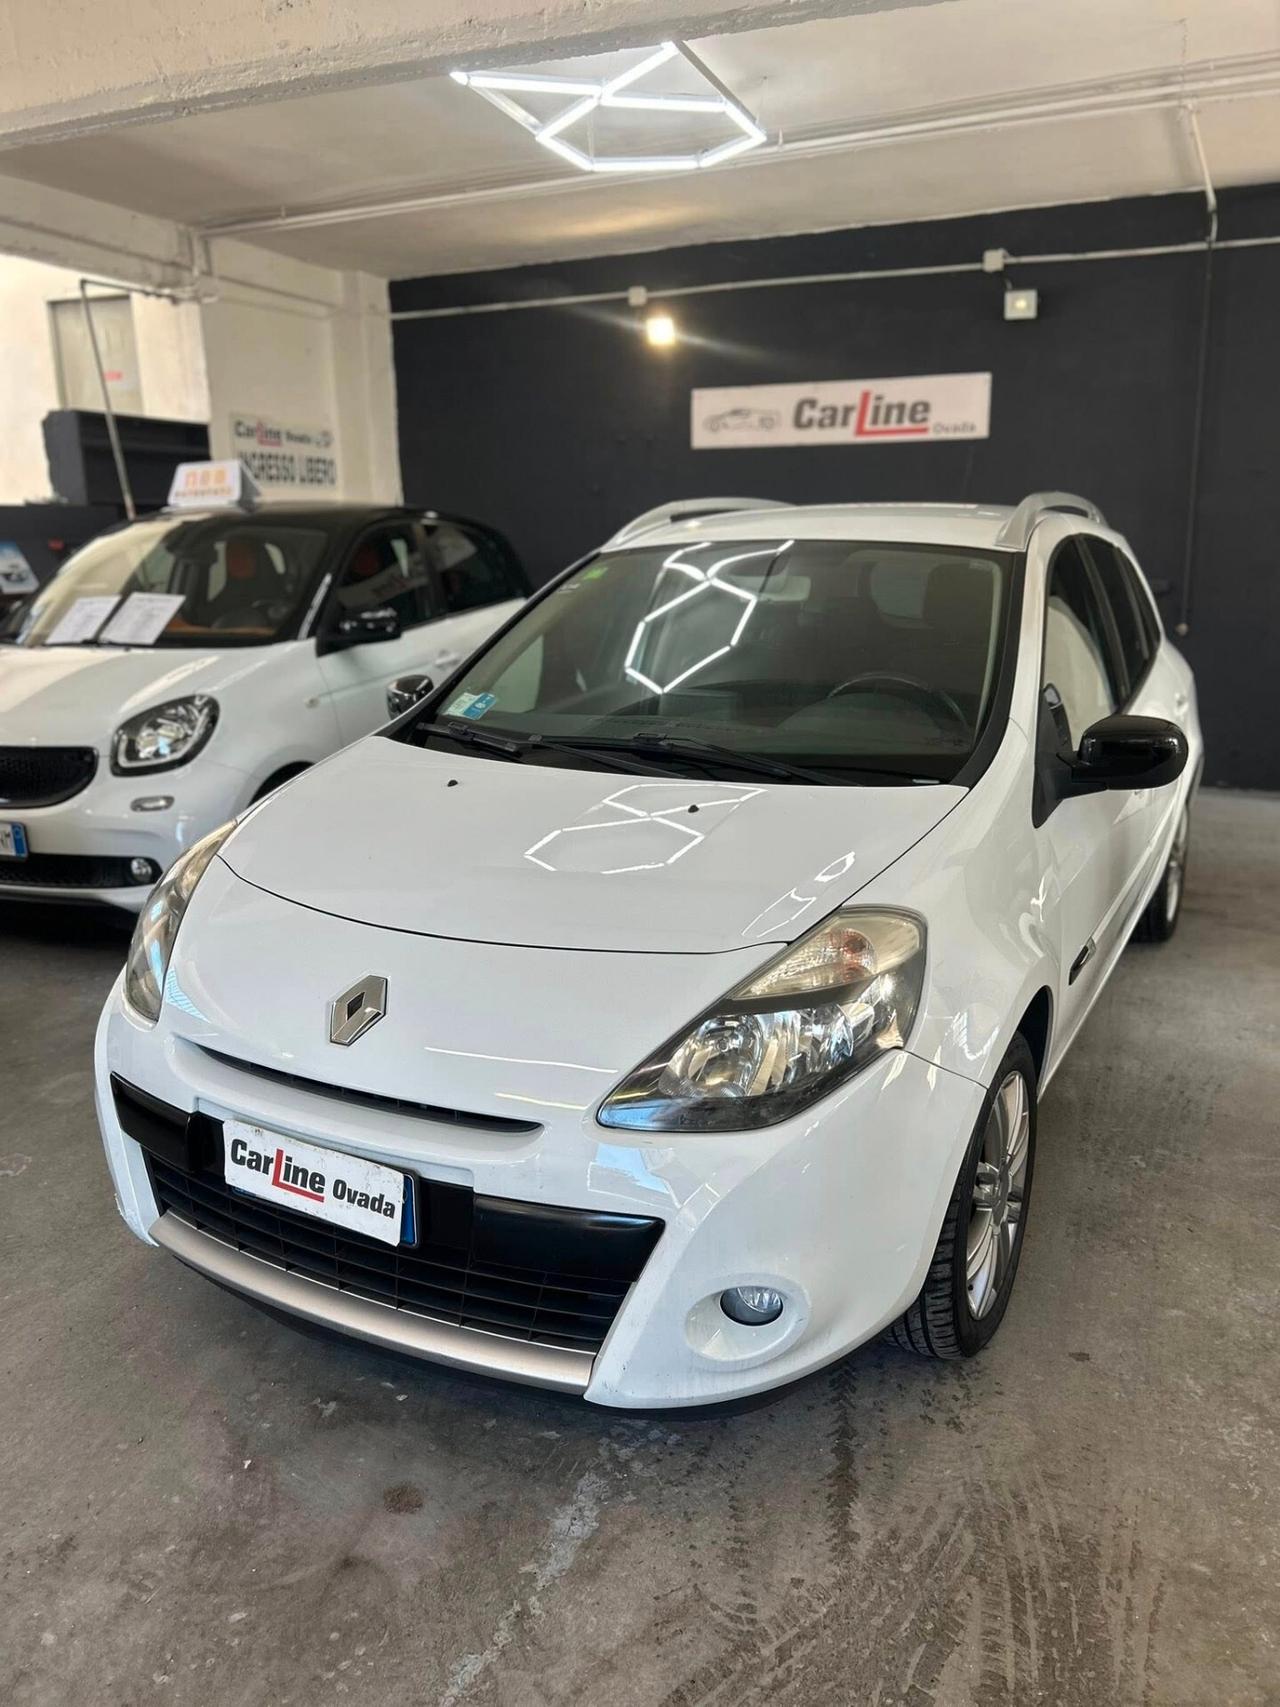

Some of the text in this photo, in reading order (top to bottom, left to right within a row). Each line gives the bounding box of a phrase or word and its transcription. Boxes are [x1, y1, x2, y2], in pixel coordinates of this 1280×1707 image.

[793, 390, 931, 437] CarLine
[231, 1139, 396, 1219] CarLine Ovada
